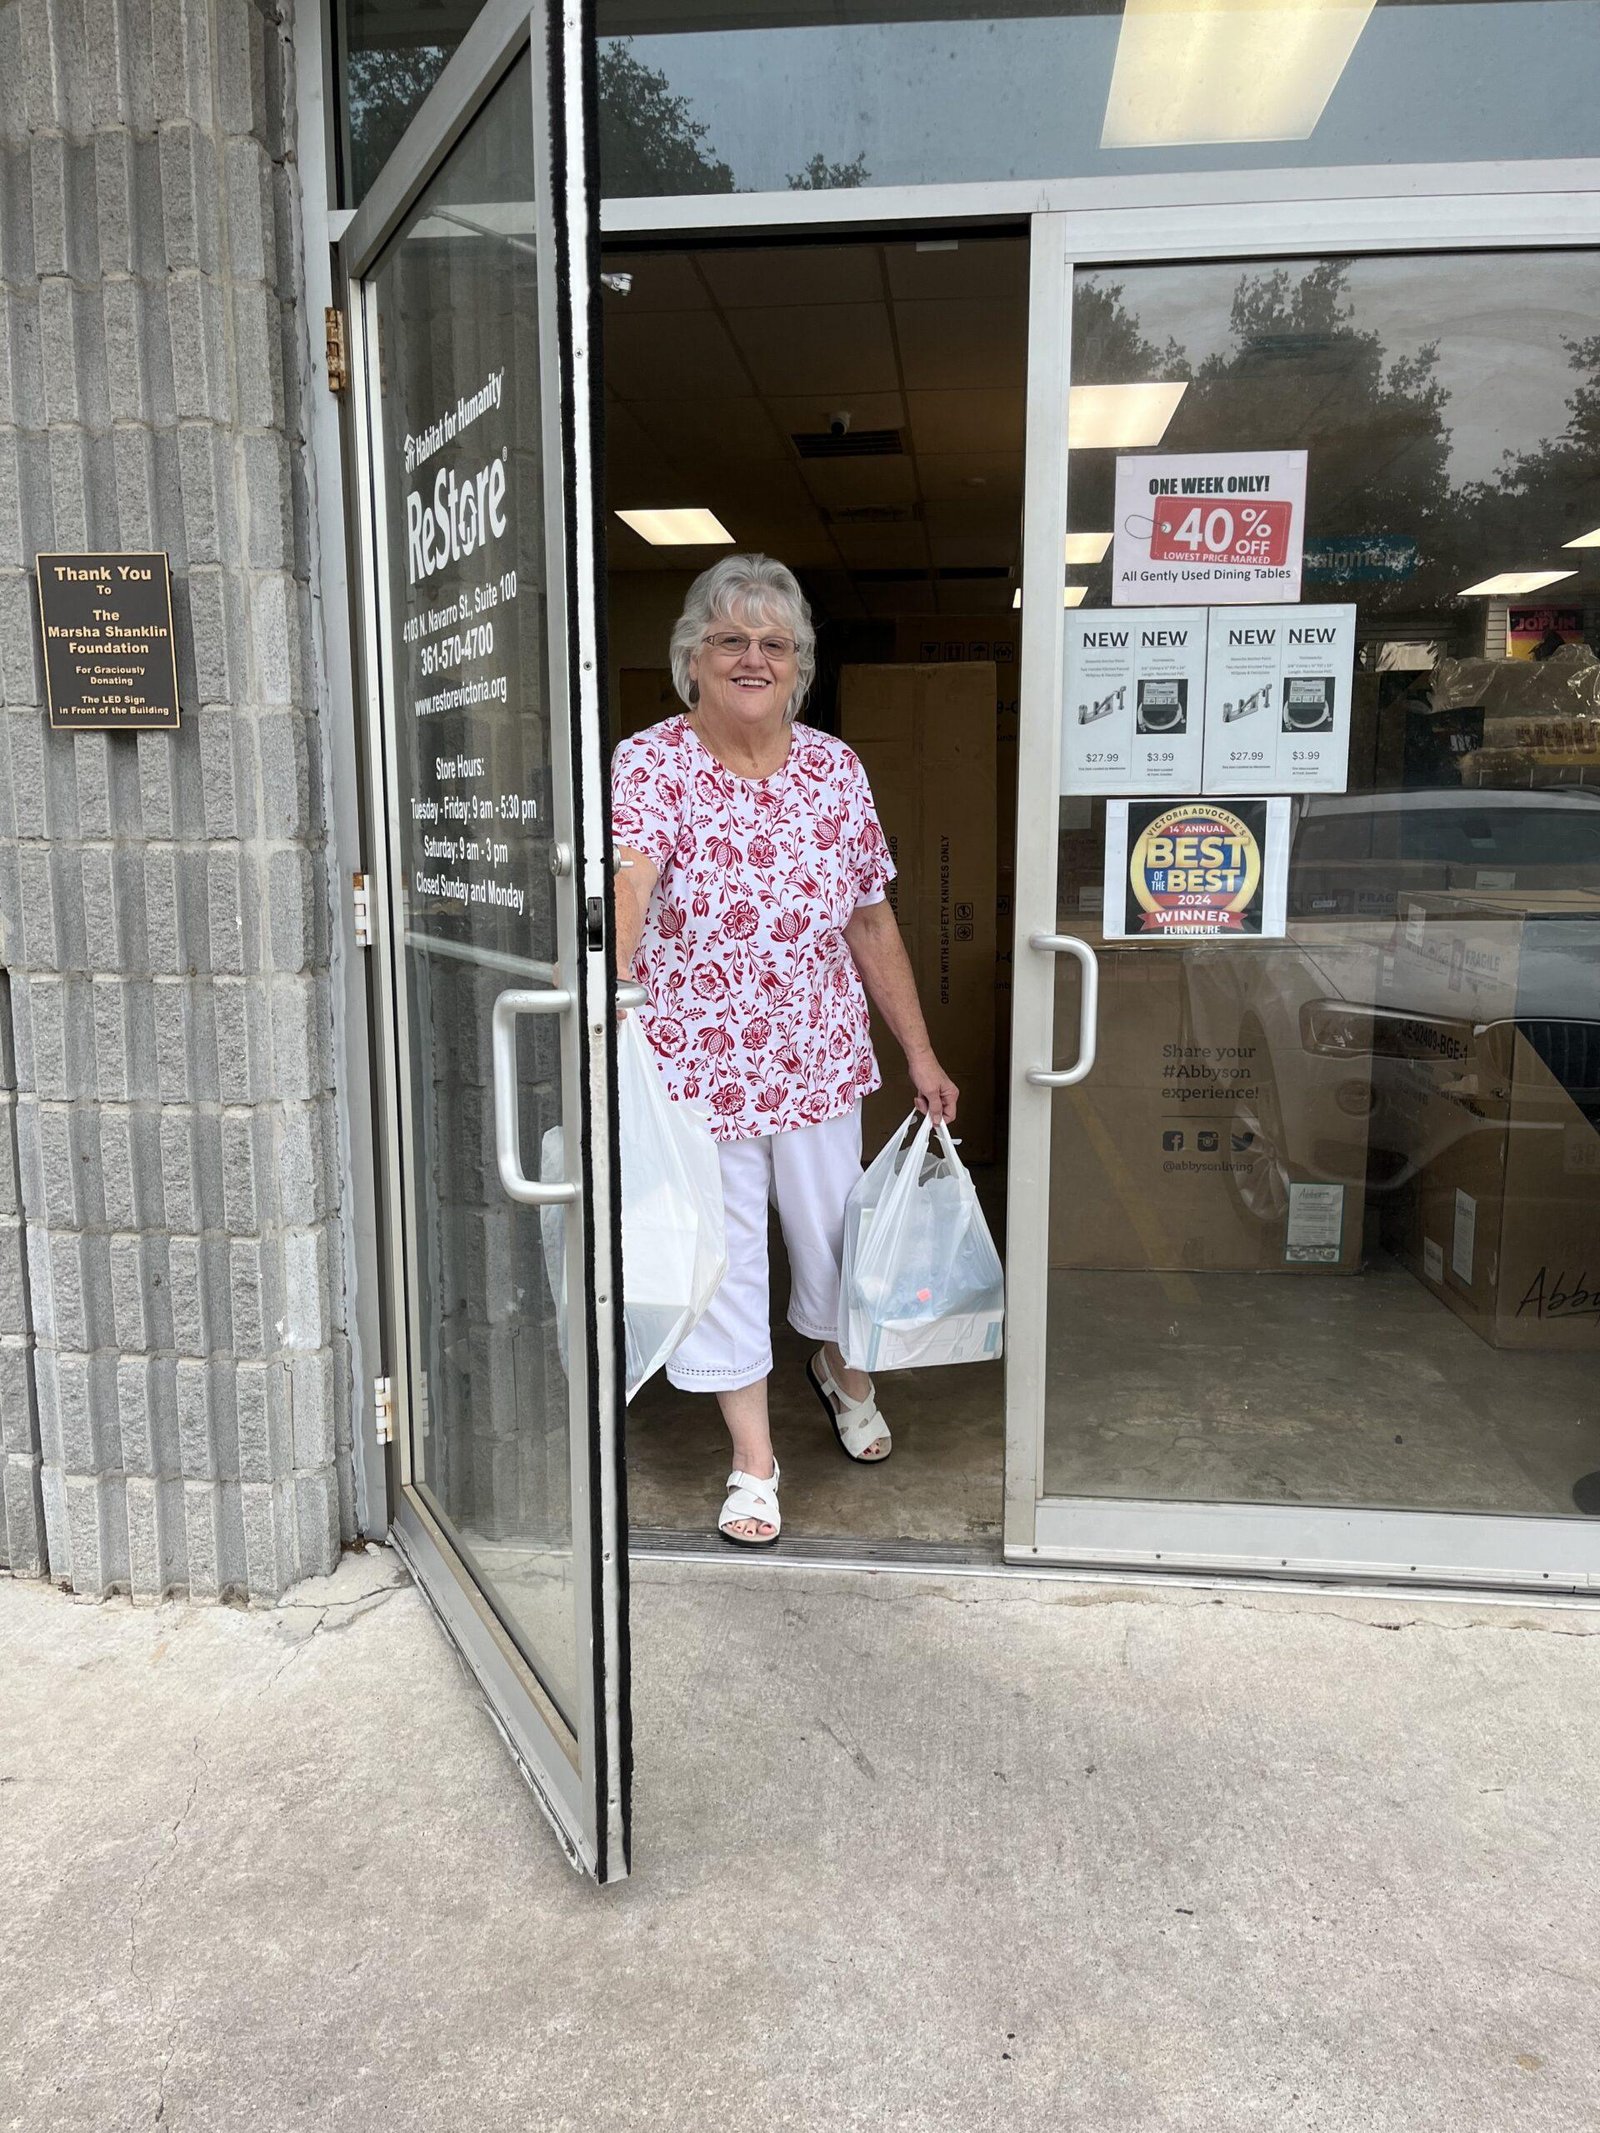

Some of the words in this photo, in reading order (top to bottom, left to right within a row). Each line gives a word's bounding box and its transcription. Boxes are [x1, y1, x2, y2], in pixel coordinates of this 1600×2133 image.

[416, 421, 444, 466] Habitat
[444, 411, 457, 443] for
[457, 372, 502, 431] Humanity
[1149, 479, 1177, 495] ONE
[1181, 477, 1224, 494] WEEK
[1227, 475, 1269, 492] ONLY!
[407, 458, 507, 584] ReStore
[1235, 540, 1270, 554] OFF
[1164, 552, 1199, 561] LOWEST
[1203, 554, 1228, 563] PRICE
[1230, 555, 1270, 564] MARKED
[54, 567, 112, 581] Thank
[117, 567, 151, 580] You
[1122, 570, 1137, 581] All
[1140, 569, 1178, 583] Gently
[1182, 569, 1210, 580] Used
[1214, 569, 1251, 581] Dining
[1255, 568, 1291, 578] Tables
[97, 585, 112, 595] To
[403, 617, 418, 643] 4103
[420, 615, 427, 637] N.
[429, 604, 458, 633] Navarro
[459, 595, 473, 620] St.,
[475, 583, 497, 613] Suite
[500, 571, 516, 601] 100
[93, 610, 119, 621] The
[1514, 617, 1576, 630] JOPLIN
[48, 627, 100, 637] Marsha
[105, 626, 168, 637] Shanklin
[1142, 631, 1188, 646] NEW
[1229, 630, 1276, 644] NEW
[1289, 628, 1336, 643] NEW
[1083, 632, 1128, 647] NEW
[69, 643, 149, 654] Foundation
[421, 622, 493, 676] 361-570-4700
[76, 666, 91, 674] For
[94, 666, 145, 676] Graciously
[91, 677, 133, 686] Donating
[82, 696, 100, 704] The
[124, 695, 145, 705] Sign
[415, 676, 507, 717] www.restorevictoria.org
[130, 706, 169, 715] Building
[1086, 753, 1118, 763] $27.99
[1147, 752, 1174, 762] $3.99
[1230, 752, 1263, 761] $27.99
[1292, 751, 1320, 760] $3.99
[436, 757, 455, 780] Store
[457, 755, 484, 777] Hours:
[411, 798, 438, 825] Tuesday
[444, 796, 470, 824] Friday:
[473, 795, 477, 819] 9
[480, 801, 493, 818] am
[501, 794, 519, 819] 5:30
[522, 799, 536, 825] pm
[1147, 809, 1188, 836] VICTORIA
[1192, 808, 1246, 836] ADVOCATE'S
[424, 835, 458, 864] Saturday:
[460, 836, 464, 860] 9
[467, 842, 479, 860] am
[486, 838, 491, 861] 3
[494, 843, 507, 868] pm
[942, 835, 950, 863] ONLY
[1146, 837, 1251, 869] BEST
[1154, 871, 1163, 881] OF
[1167, 870, 1240, 892] BEST
[941, 865, 949, 904] KNIVES
[1152, 881, 1165, 890] THE
[417, 872, 439, 894] Closed
[441, 874, 468, 906] Sunday
[471, 880, 486, 902] and
[488, 880, 524, 915] Monday
[1178, 895, 1211, 905] 2024
[1359, 892, 1395, 903] FRAG
[1156, 910, 1229, 923] WINNER
[941, 907, 949, 947] SAFETY
[1164, 925, 1221, 934] FURNITURE
[941, 949, 949, 976] WITH
[1465, 950, 1501, 972] FRAGILE
[941, 977, 949, 1004] OPEN
[1162, 1044, 1211, 1058] Share
[1216, 1048, 1256, 1062] your
[1162, 1065, 1251, 1081] #Abbyson
[1162, 1086, 1258, 1101] experience!
[1163, 1161, 1254, 1172] @abbysonliving
